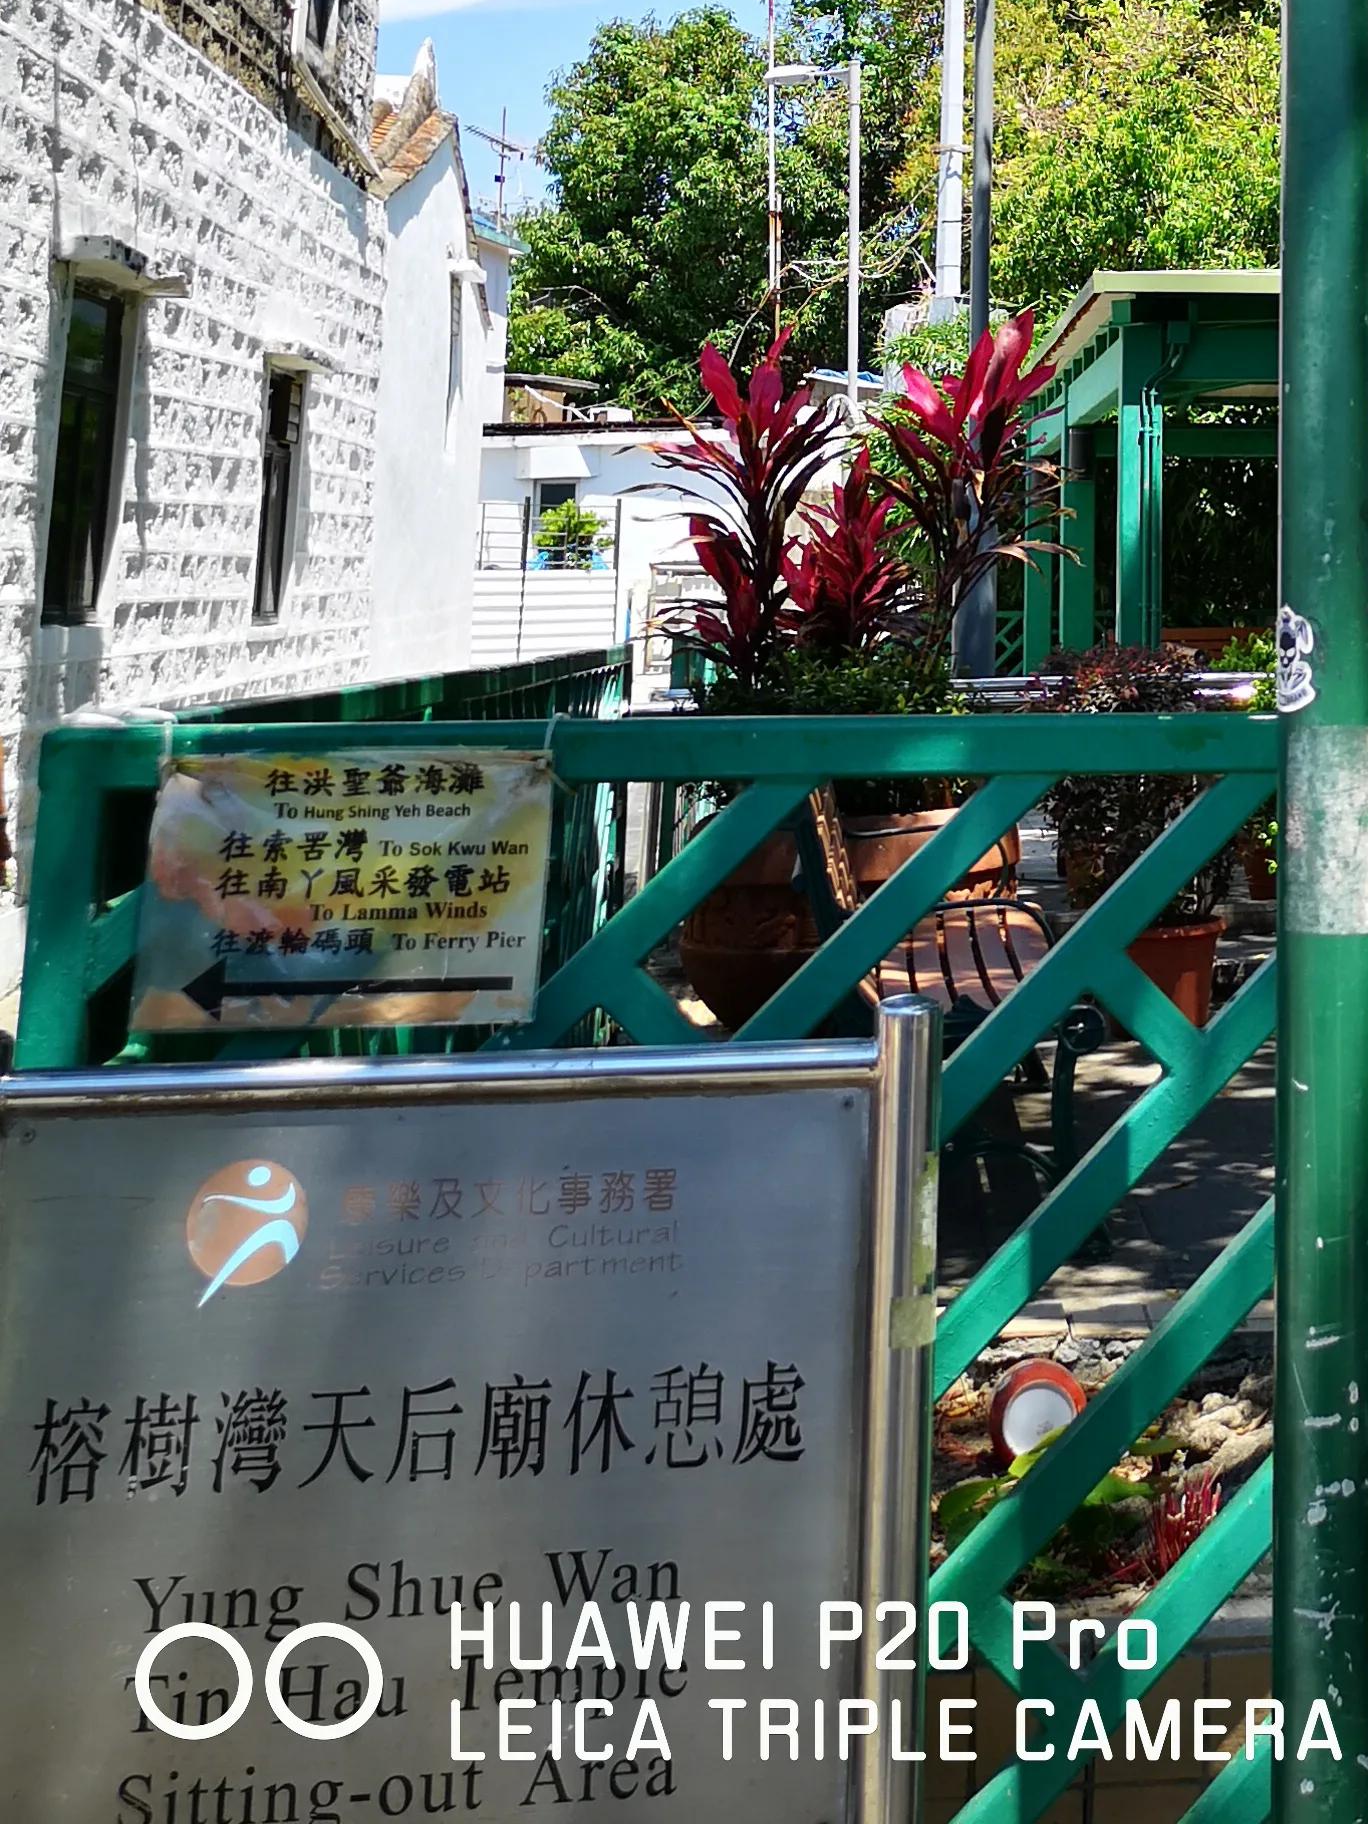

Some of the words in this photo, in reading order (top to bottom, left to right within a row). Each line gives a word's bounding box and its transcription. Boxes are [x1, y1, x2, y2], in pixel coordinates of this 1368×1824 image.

[264, 763, 486, 798] 往洪聖爺海灘
[274, 802, 299, 820] To
[304, 805, 345, 822] Hung
[348, 804, 390, 821] Shing
[394, 804, 422, 818] Yeh
[425, 803, 471, 818] Beach
[379, 840, 403, 858] To
[409, 840, 443, 857] Sok
[447, 841, 486, 857] Kwu
[491, 840, 529, 856] Wan
[309, 904, 334, 922] To
[342, 903, 418, 921] Lamma
[425, 901, 488, 919] Winds
[210, 927, 374, 957] 往渡輪碼頭
[391, 933, 417, 952] To
[423, 932, 481, 955] Ferry
[485, 931, 526, 950] Pier
[330, 1234, 450, 1261] Lisure
[548, 1221, 678, 1248] Cultural
[28, 1360, 808, 1508] 榕樹灣天后廟休憩處
[132, 1575, 304, 1643] Yung
[344, 1558, 503, 1622] Shue
[544, 1548, 682, 1608] Wan
[117, 1760, 483, 1824] Sitting-out
[519, 1748, 679, 1808] Area
